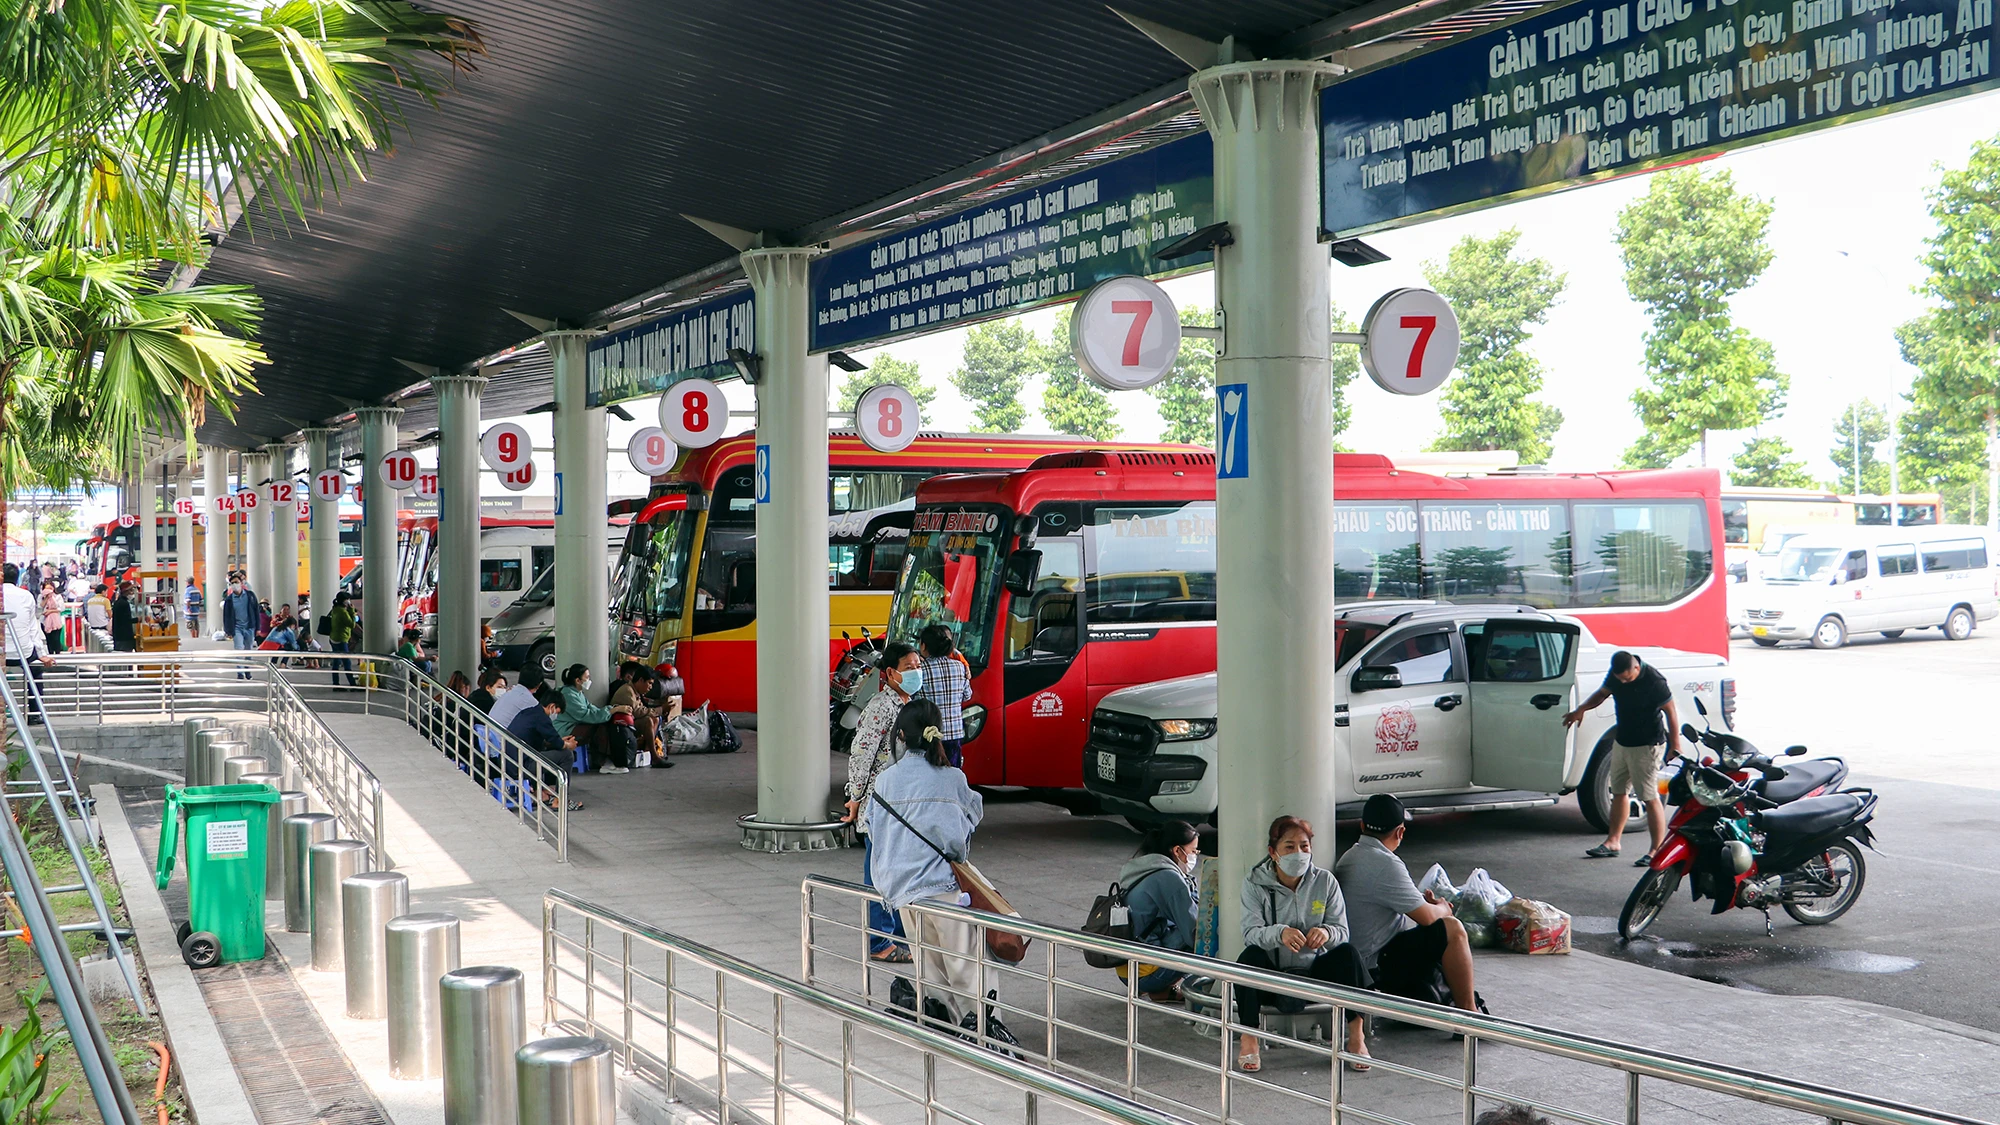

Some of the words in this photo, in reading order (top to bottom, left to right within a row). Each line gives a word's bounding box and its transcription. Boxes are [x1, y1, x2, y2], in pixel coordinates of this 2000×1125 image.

[1489, 29, 1537, 79] CẦN
[1543, 9, 1595, 62] THƠ
[1601, 2, 1628, 45] ĐI
[1344, 131, 1365, 160] Trà
[1403, 111, 1447, 150] Duyên
[1452, 97, 1479, 131] Hải,
[1482, 90, 1508, 122] Trà
[1513, 81, 1538, 112] Cú,
[1540, 67, 1576, 105] Tiểu
[1582, 56, 1620, 94] Cần,
[1623, 43, 1659, 82] Bến
[1665, 37, 1701, 70] Tre,
[1705, 20, 1736, 59] Mỏ
[1743, 11, 1787, 47] Cày,
[1360, 156, 1407, 190] Trường
[1411, 144, 1451, 177] Xuân,
[1452, 135, 1485, 166] Tam
[1490, 123, 1533, 156] Nông,
[1536, 113, 1561, 144] Mỹ
[1564, 104, 1600, 137] Tho,
[1603, 94, 1627, 127] Gò
[1633, 87, 1684, 119] Công,
[1688, 68, 1734, 105] Kiến
[1738, 49, 1812, 91] Tường,
[1814, 28, 1866, 72] Vĩnh
[1876, 12, 1949, 55] Hưng,
[1587, 131, 1622, 170] Bến
[1628, 125, 1660, 159] Cát
[1671, 111, 1708, 150] Phú
[1718, 94, 1786, 138] Chánh
[1812, 70, 1845, 116] TỪ
[1852, 61, 1898, 108] CỘT
[1902, 56, 1935, 94] 04
[1939, 31, 1990, 86] ĐẾN
[870, 241, 888, 270] CẦN
[889, 235, 907, 264] THƠ
[920, 227, 939, 254] CÁC
[1027, 189, 1043, 223] HỒ
[1045, 184, 1065, 217] CHÍ
[1067, 178, 1099, 211] MINH
[1038, 224, 1060, 244] Vũng
[1061, 217, 1080, 238] Tàu,
[1082, 211, 1103, 233] Long
[1152, 188, 1176, 213] Linh,
[1061, 245, 1077, 265] Tuy
[1079, 240, 1099, 260] Hòa,
[1101, 234, 1119, 255] Quy
[995, 284, 1010, 308] CỘT
[1010, 284, 1020, 303] 04
[1039, 274, 1055, 299] CỘT
[1057, 273, 1069, 294] 08
[642, 323, 672, 381] KHÁCH
[673, 314, 687, 374] CÓ
[689, 309, 708, 369] MÁI
[709, 308, 729, 364] CHE
[731, 299, 754, 354] CHO
[1111, 301, 1153, 366] 7
[1400, 316, 1437, 379] 7
[682, 391, 709, 432] 8
[878, 398, 903, 437] 8
[498, 432, 518, 463] 9
[646, 436, 666, 465] 9
[318, 475, 341, 495] 11
[385, 457, 415, 482] 10
[418, 474, 437, 494] 11
[176, 501, 193, 514] 15
[217, 497, 235, 511] 14
[237, 493, 257, 508] 13
[270, 484, 292, 502] 12
[121, 516, 133, 526] 16
[944, 506, 988, 532] BÌNH
[1111, 513, 1168, 537] TÂM
[1386, 508, 1418, 533] SÓC
[1421, 507, 1473, 532] TRĂNG
[1486, 503, 1517, 532] CẦN
[1520, 508, 1550, 531] THƠ
[1359, 769, 1424, 784] WILDTRAK
